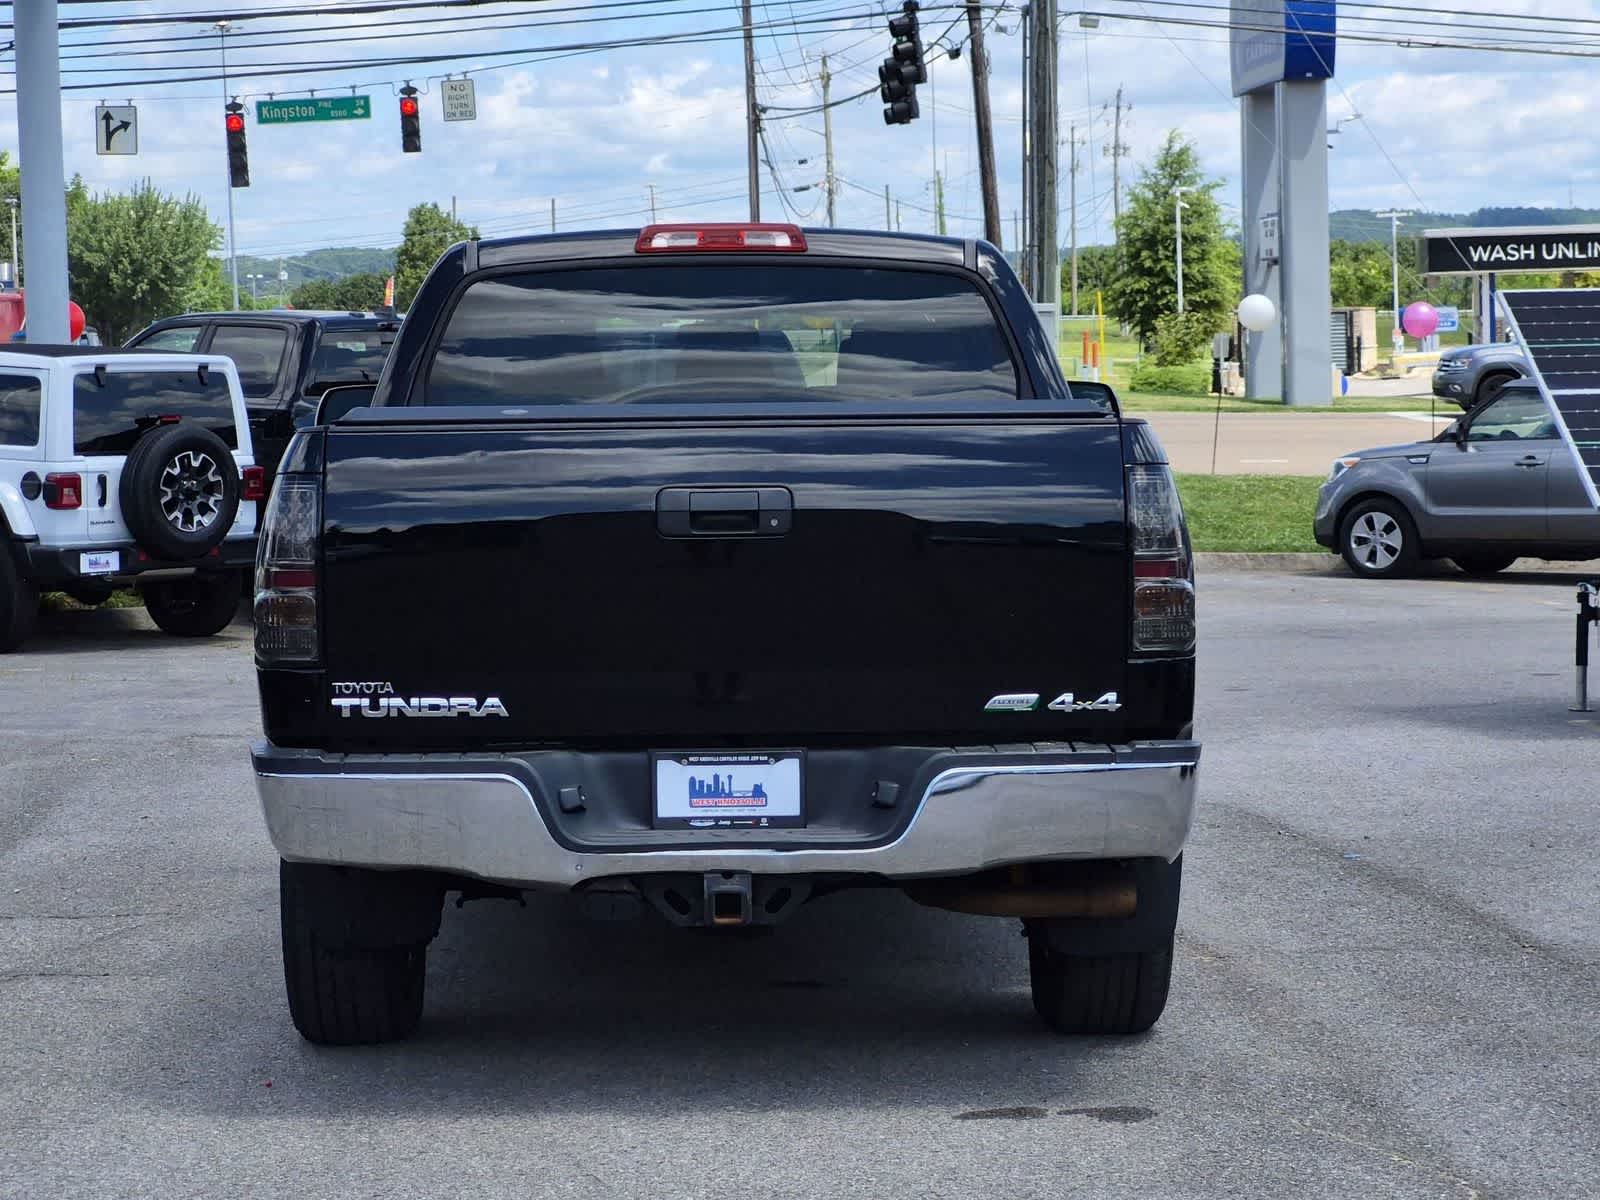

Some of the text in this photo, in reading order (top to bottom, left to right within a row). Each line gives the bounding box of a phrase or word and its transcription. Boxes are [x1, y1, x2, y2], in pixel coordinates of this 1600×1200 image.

[262, 105, 316, 120] Kingston
[1469, 244, 1535, 262] WASH
[332, 682, 394, 694] TOYOTA
[331, 697, 510, 718] TUNDRA
[1048, 692, 1122, 712] 4x4
[717, 798, 765, 806] KNOXVILLE
